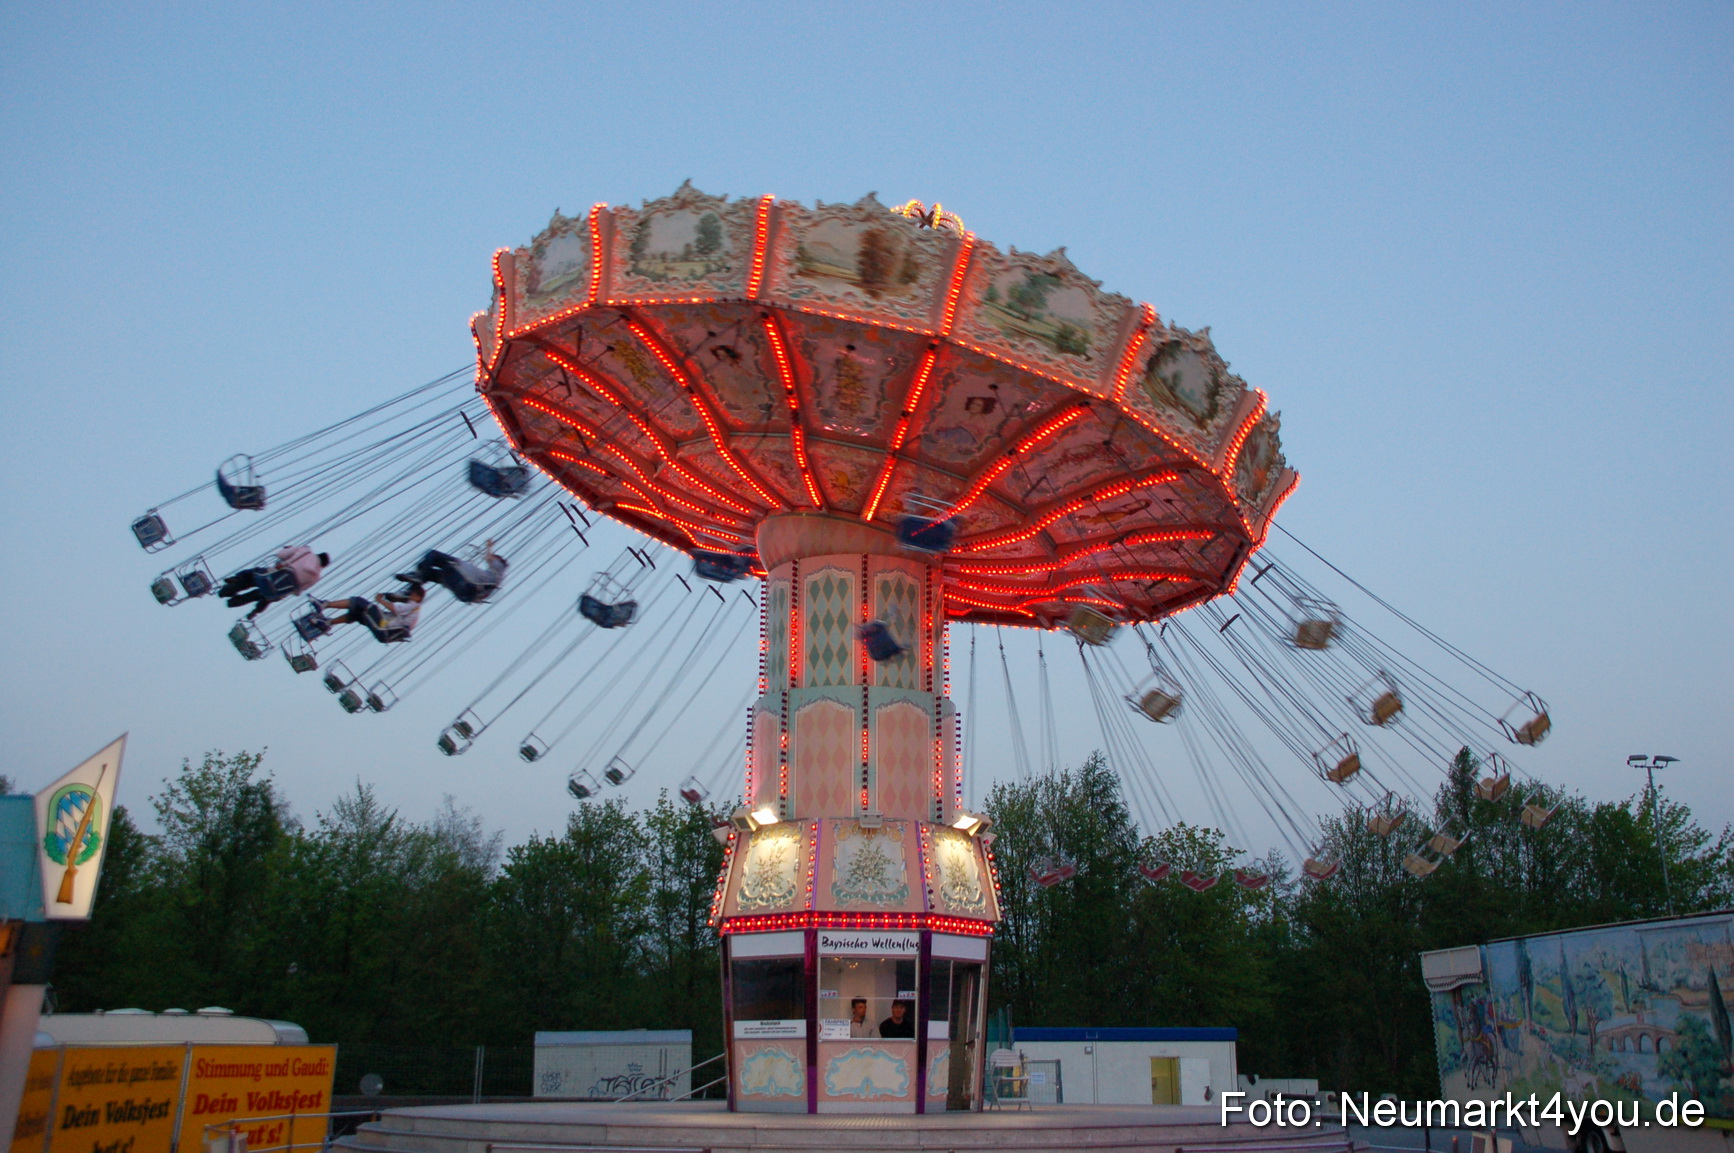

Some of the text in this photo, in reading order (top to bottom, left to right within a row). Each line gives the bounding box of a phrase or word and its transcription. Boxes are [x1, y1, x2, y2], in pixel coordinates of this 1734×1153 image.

[822, 936, 868, 951] Bayrischer
[196, 1057, 330, 1082] Stimmung und Gaudi:
[62, 1103, 101, 1130] Dein
[106, 1098, 171, 1126] Volksfest
[193, 1090, 323, 1115] Dein Volksfest
